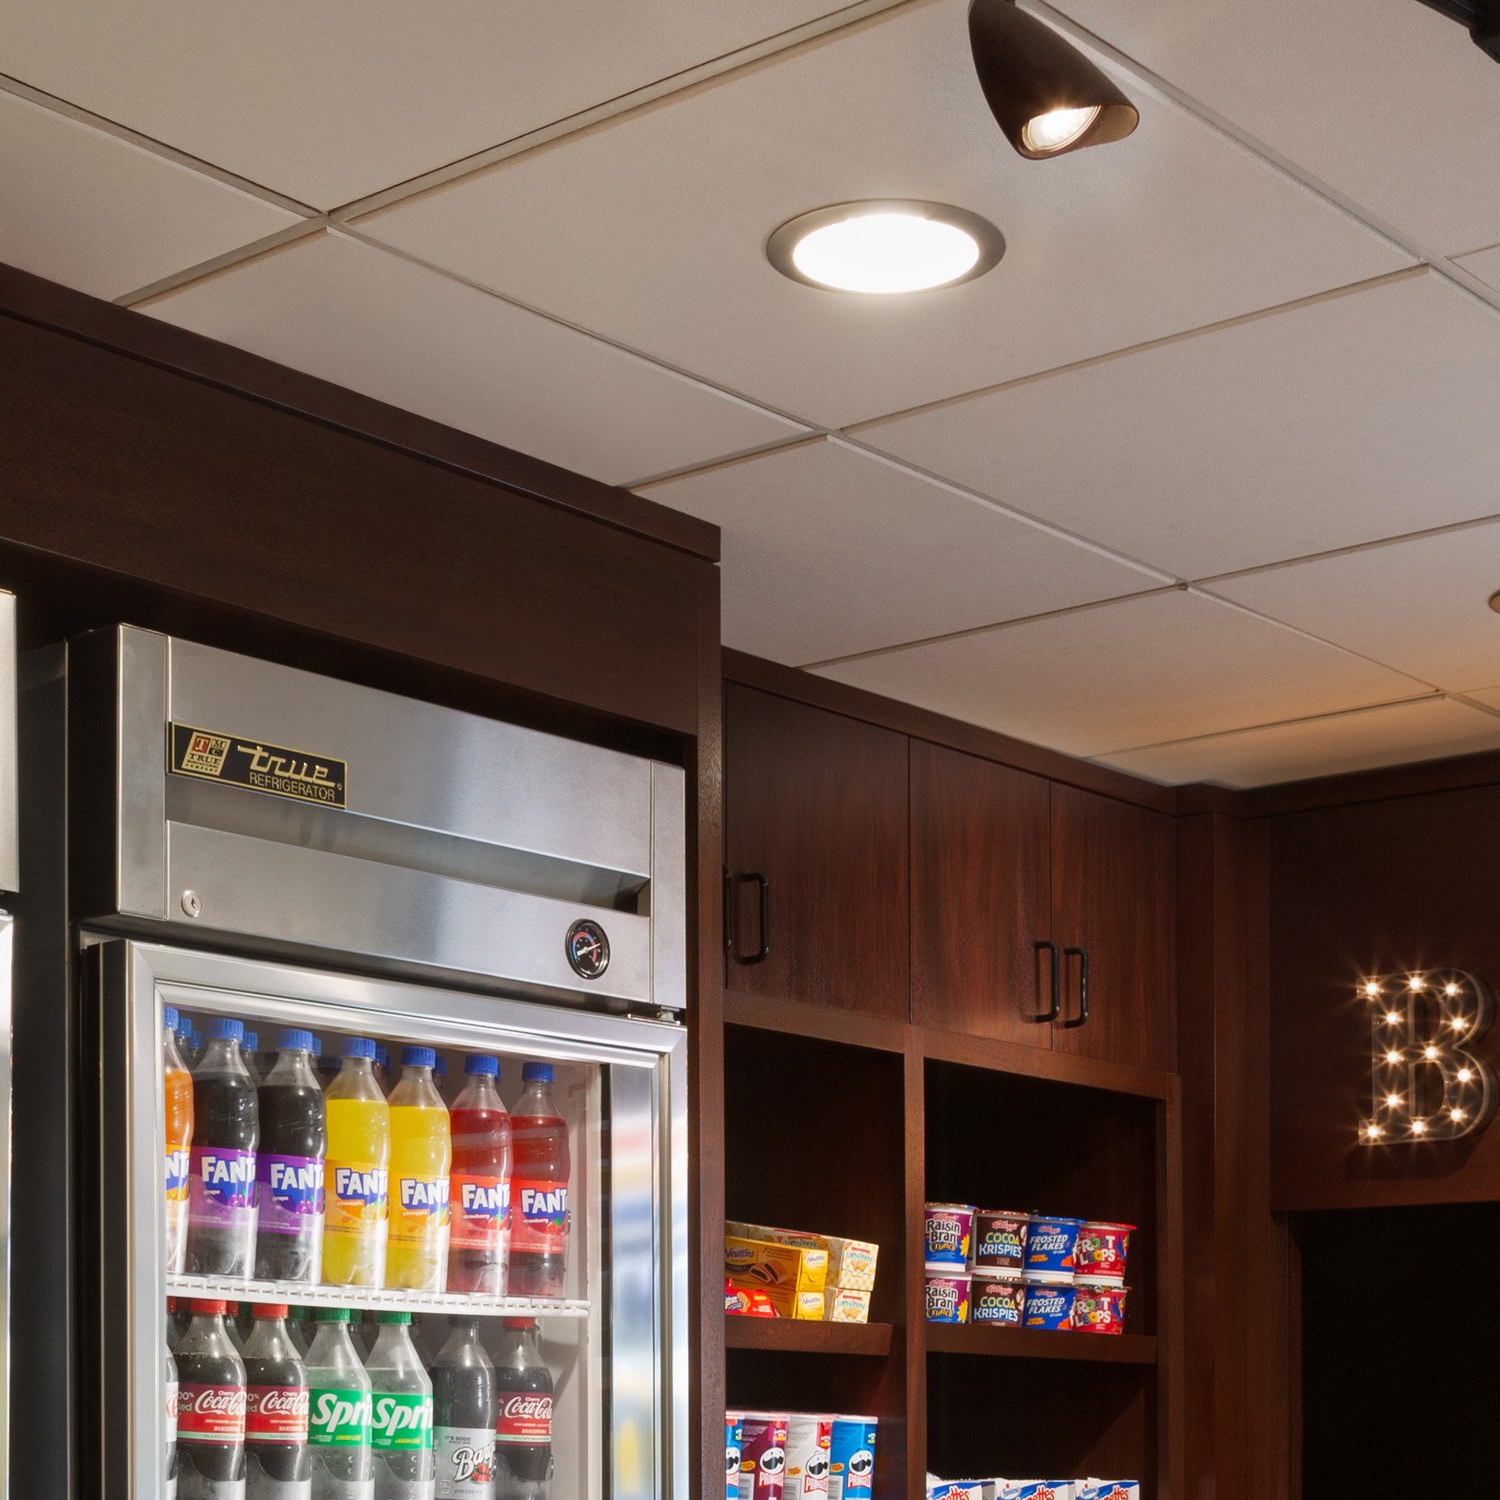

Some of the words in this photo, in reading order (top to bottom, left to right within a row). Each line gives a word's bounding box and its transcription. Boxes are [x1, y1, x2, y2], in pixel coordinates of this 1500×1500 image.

[189, 752, 221, 765] TRUE
[237, 745, 335, 787] true
[250, 771, 335, 801] REFRIGERATOR
[201, 1156, 255, 1184] FANT
[400, 1179, 449, 1205] FANT
[927, 1220, 960, 1234] Raisin
[930, 1232, 956, 1243] Bran
[986, 1232, 1019, 1245] COCOA
[1030, 1234, 1068, 1244] FROSTED
[725, 1248, 754, 1258] Newtons
[979, 1243, 1022, 1257] KRISPIES
[1031, 1242, 1064, 1251] FLAKES
[1079, 1249, 1115, 1265] LOOPS
[925, 1286, 957, 1300] Raisin
[927, 1298, 953, 1309] Bran
[980, 1296, 1015, 1309] COCOA
[1027, 1297, 1065, 1307] FROSTED
[974, 1307, 1018, 1322] KRISPIES
[1029, 1305, 1061, 1314] FLAKES
[1075, 1311, 1111, 1327] LOOPS
